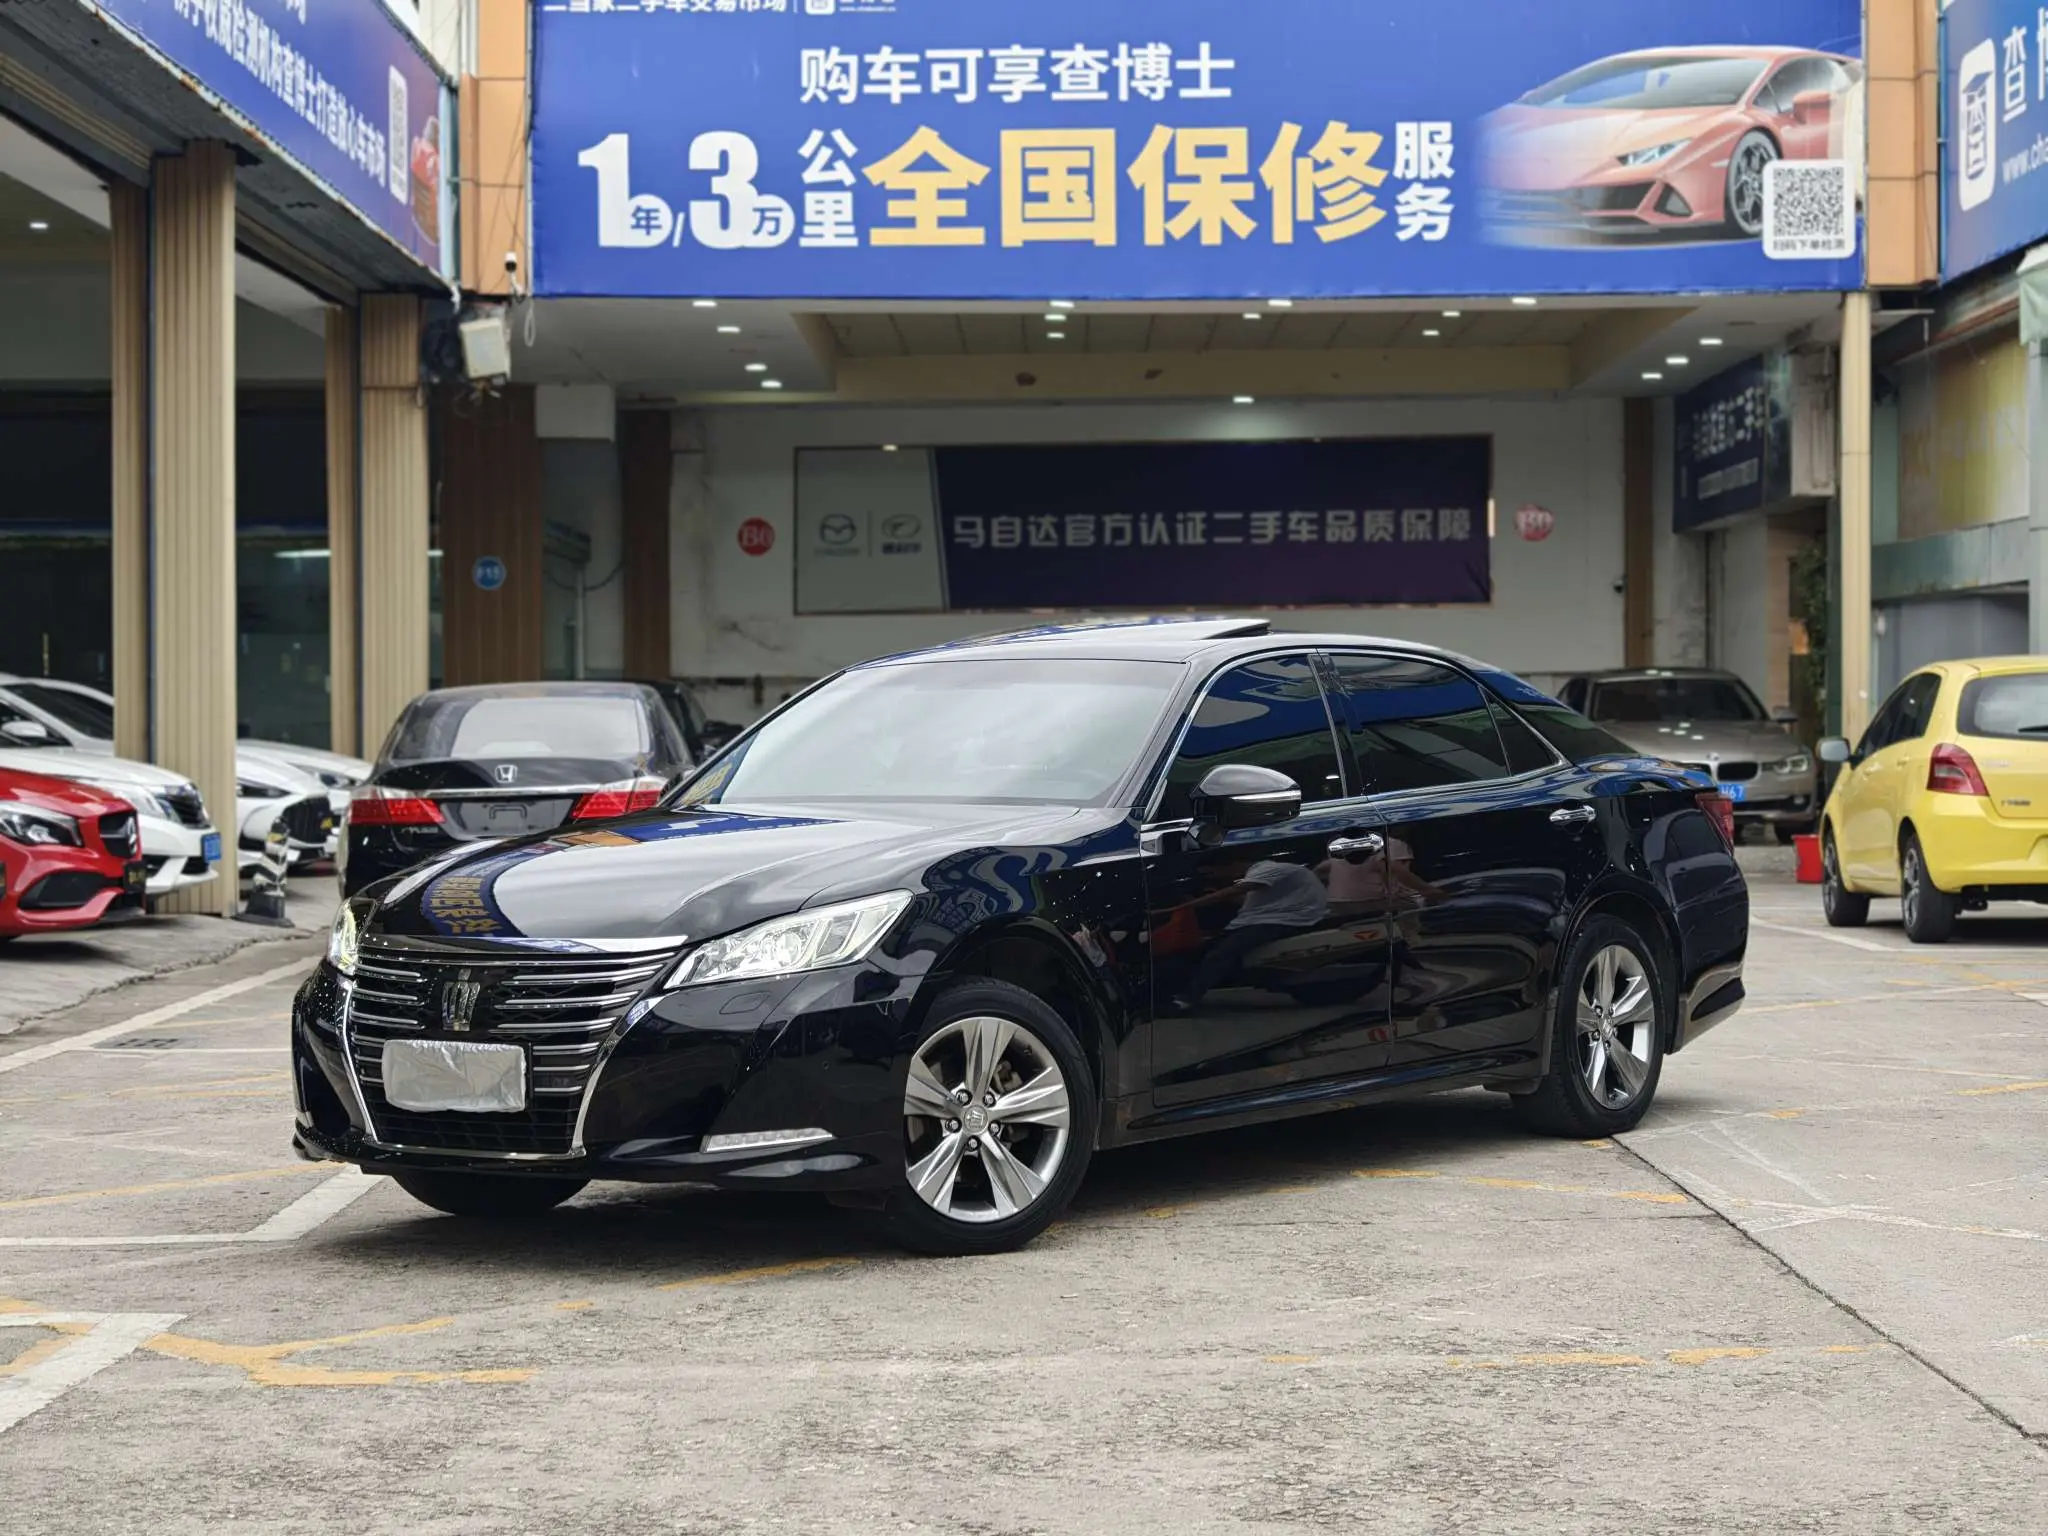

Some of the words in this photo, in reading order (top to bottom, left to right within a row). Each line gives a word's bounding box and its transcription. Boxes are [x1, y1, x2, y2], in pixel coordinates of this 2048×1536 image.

[799, 43, 1235, 103] 购车可享查博士
[862, 121, 1388, 248] 全国保修
[1394, 121, 1454, 241] 服务
[953, 509, 1472, 548] 马自达官方认证二手车品质保障
